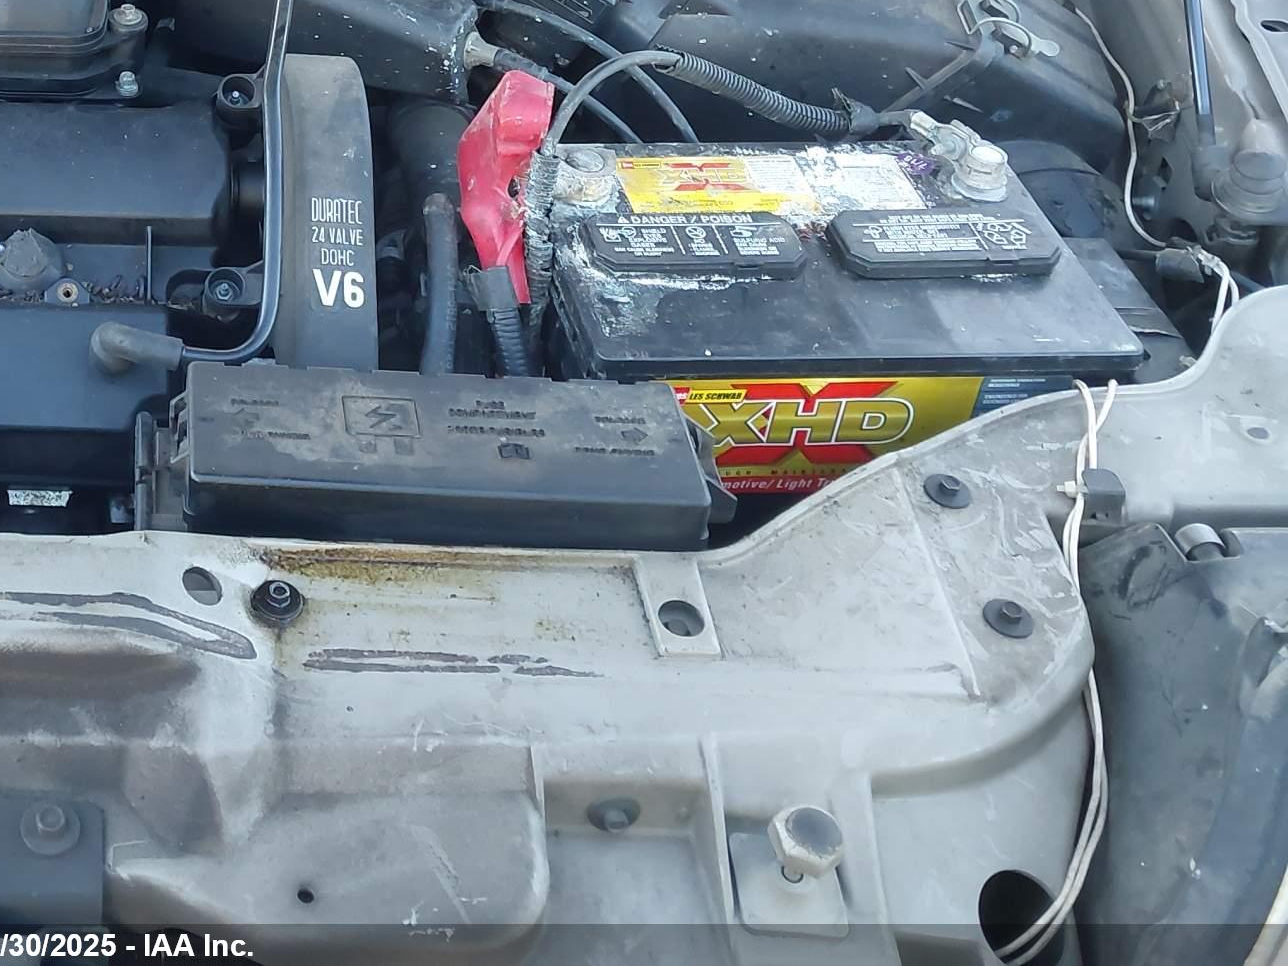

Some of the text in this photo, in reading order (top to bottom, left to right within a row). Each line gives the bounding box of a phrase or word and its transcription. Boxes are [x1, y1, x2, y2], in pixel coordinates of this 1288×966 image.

[311, 197, 364, 225] DURATEC
[630, 215, 688, 224] DANGER
[700, 214, 753, 223] POISON
[312, 226, 364, 246] 24 VALVE
[321, 248, 355, 266] DOHC
[312, 268, 365, 308] V6
[689, 392, 704, 400] LES
[706, 392, 742, 400] SCHWAB
[700, 396, 915, 447] XHD
[776, 477, 812, 490] Light
